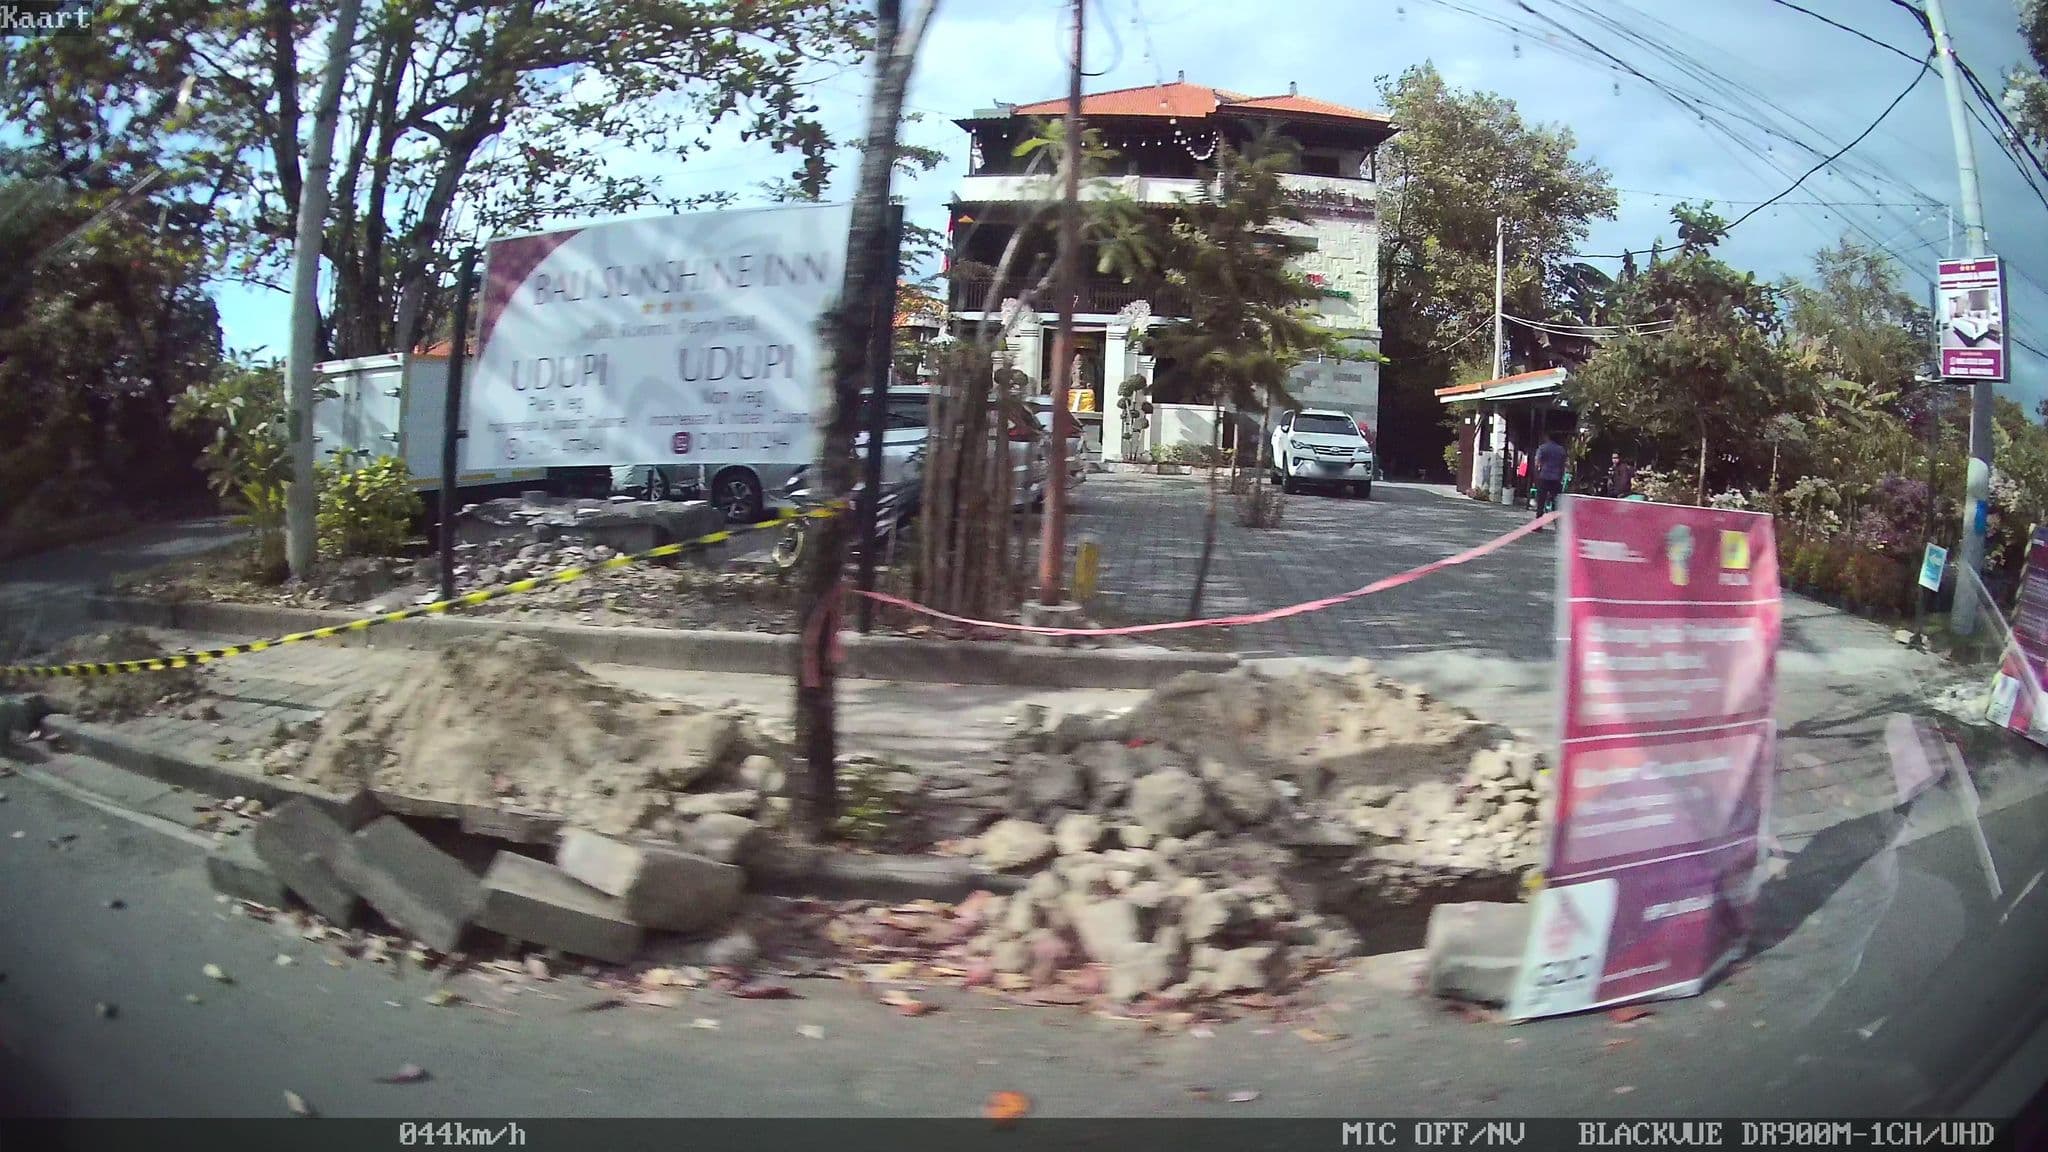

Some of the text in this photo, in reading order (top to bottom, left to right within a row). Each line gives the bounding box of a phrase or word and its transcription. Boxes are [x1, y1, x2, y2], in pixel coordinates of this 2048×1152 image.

[602, 254, 753, 298] SUNSHINE
[763, 250, 829, 287] INN
[511, 353, 608, 391] UDUPI
[680, 343, 795, 382] UDUPI
